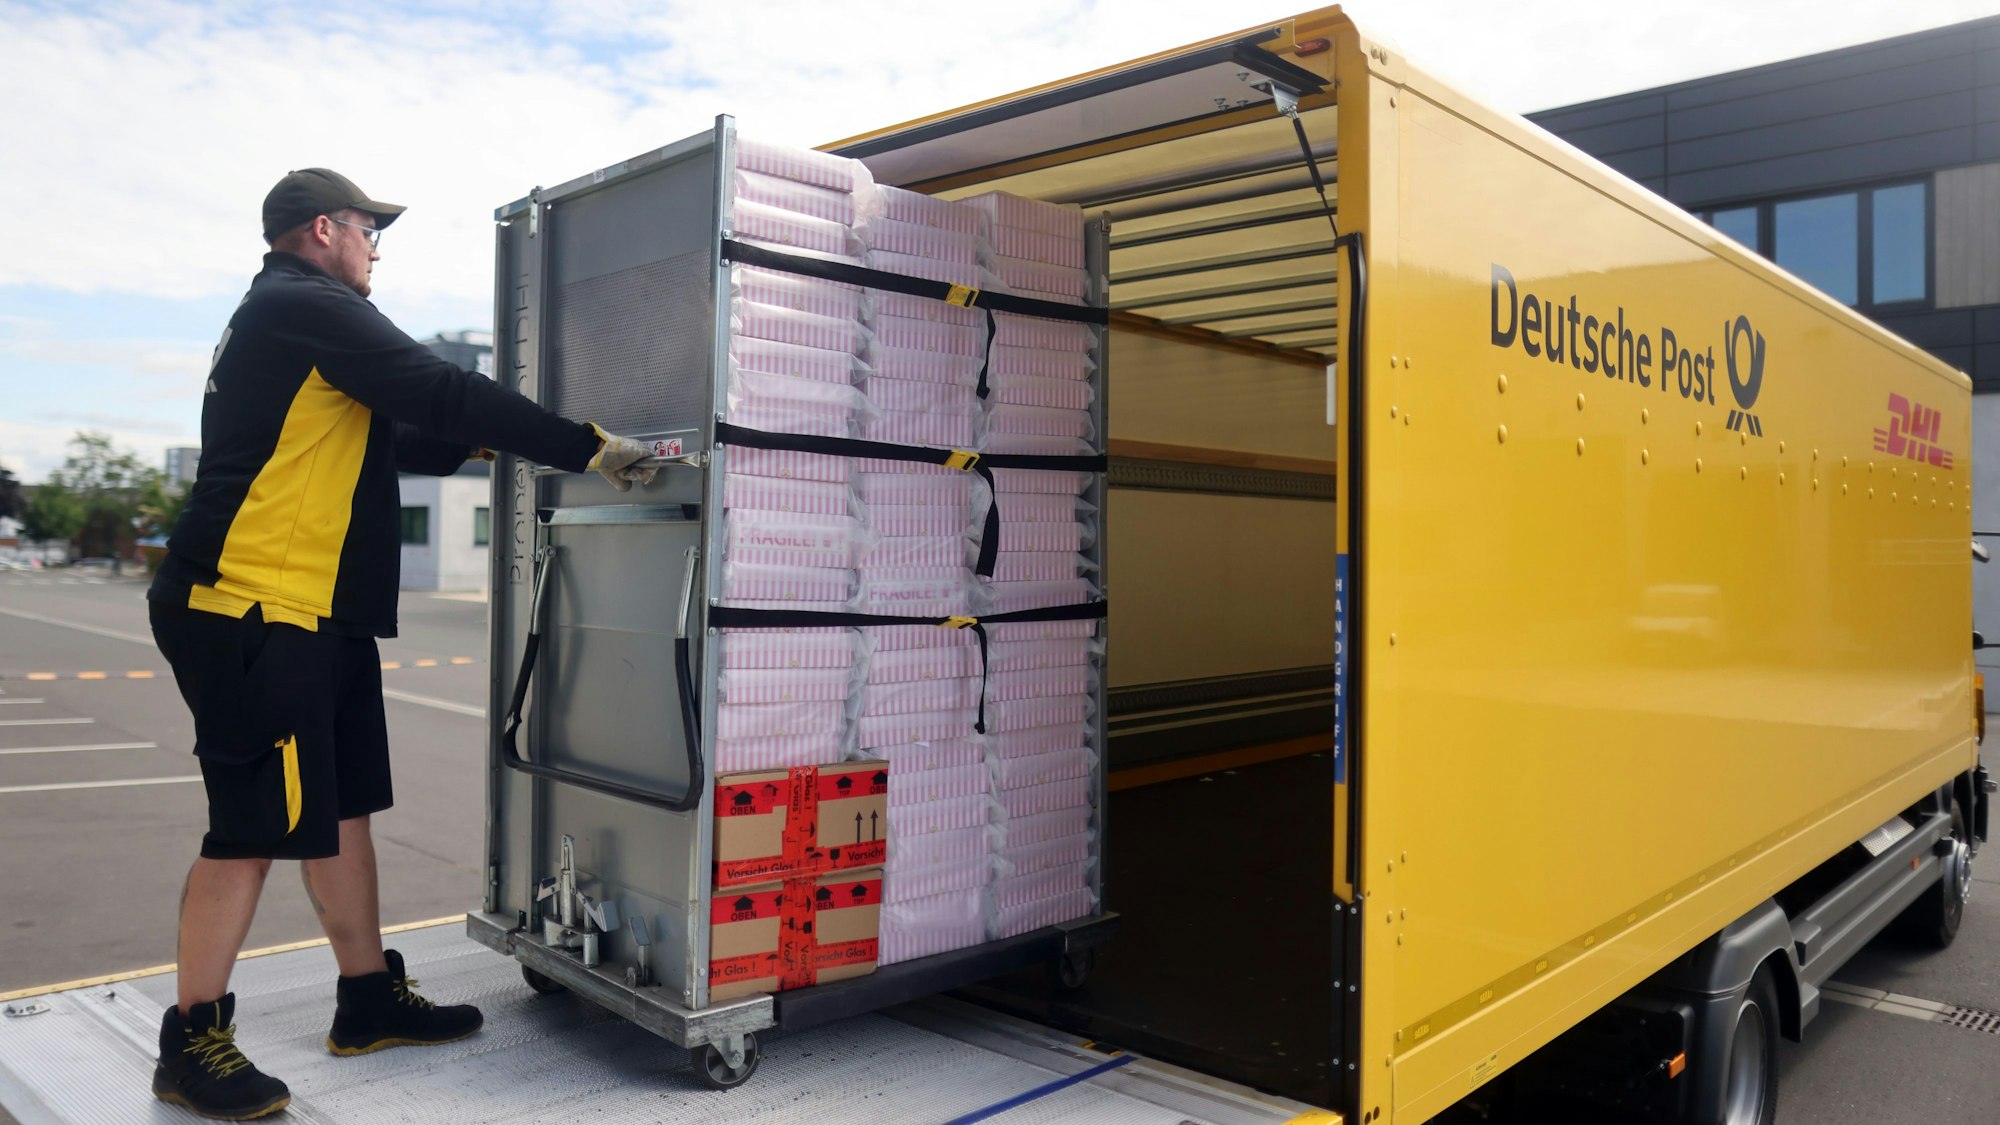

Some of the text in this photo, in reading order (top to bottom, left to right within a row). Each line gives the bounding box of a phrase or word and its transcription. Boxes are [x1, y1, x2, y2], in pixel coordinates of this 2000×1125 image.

[1491, 263, 1715, 406] Deutsche Post
[1882, 392, 1948, 468] DHL
[1333, 578, 1343, 759] HANDGRIFF
[730, 805, 756, 816] OBEN
[847, 846, 885, 861] Vorsicht
[727, 864, 769, 880] Vorsicht
[770, 862, 794, 872] Glas
[816, 900, 835, 911] BEN
[731, 910, 757, 922] OBEN
[845, 946, 867, 958] Glas
[724, 963, 748, 976] Glas
